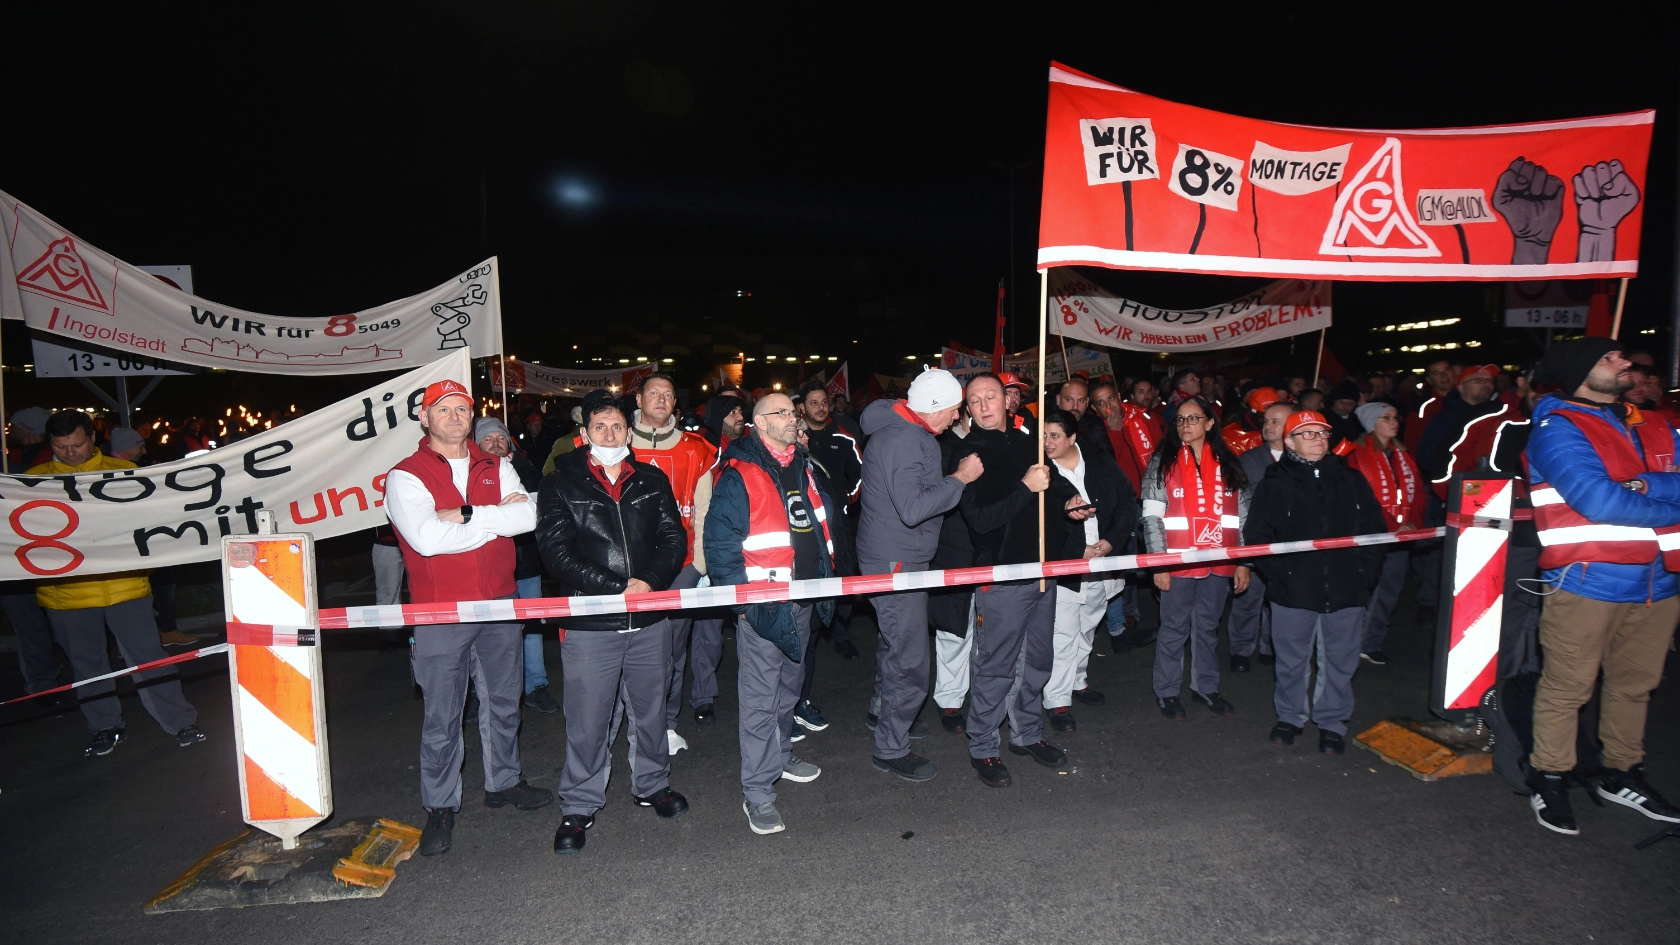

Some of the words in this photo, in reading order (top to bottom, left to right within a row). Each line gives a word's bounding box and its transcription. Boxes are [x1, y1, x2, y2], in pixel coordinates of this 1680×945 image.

[1090, 124, 1148, 149] WIR
[1098, 146, 1155, 179] FÜR
[1178, 149, 1235, 196] 8%
[1249, 158, 1342, 182] MONTAGE
[189, 304, 267, 337] WIR
[277, 326, 315, 339] für
[323, 314, 357, 337] 8
[358, 318, 402, 334] 5049
[1094, 317, 1132, 342] WIR
[1140, 331, 1183, 345] HABEN
[1185, 332, 1208, 344] EIN
[1211, 294, 1323, 341] PROBLEM!
[1526, 309, 1542, 323] 13
[1554, 309, 1569, 324] 06
[1572, 309, 1582, 324] h
[63, 314, 168, 354] Ingolstadt
[68, 352, 95, 372] 13
[117, 353, 145, 371] 06
[9, 499, 85, 576] 8
[133, 495, 264, 557] mit
